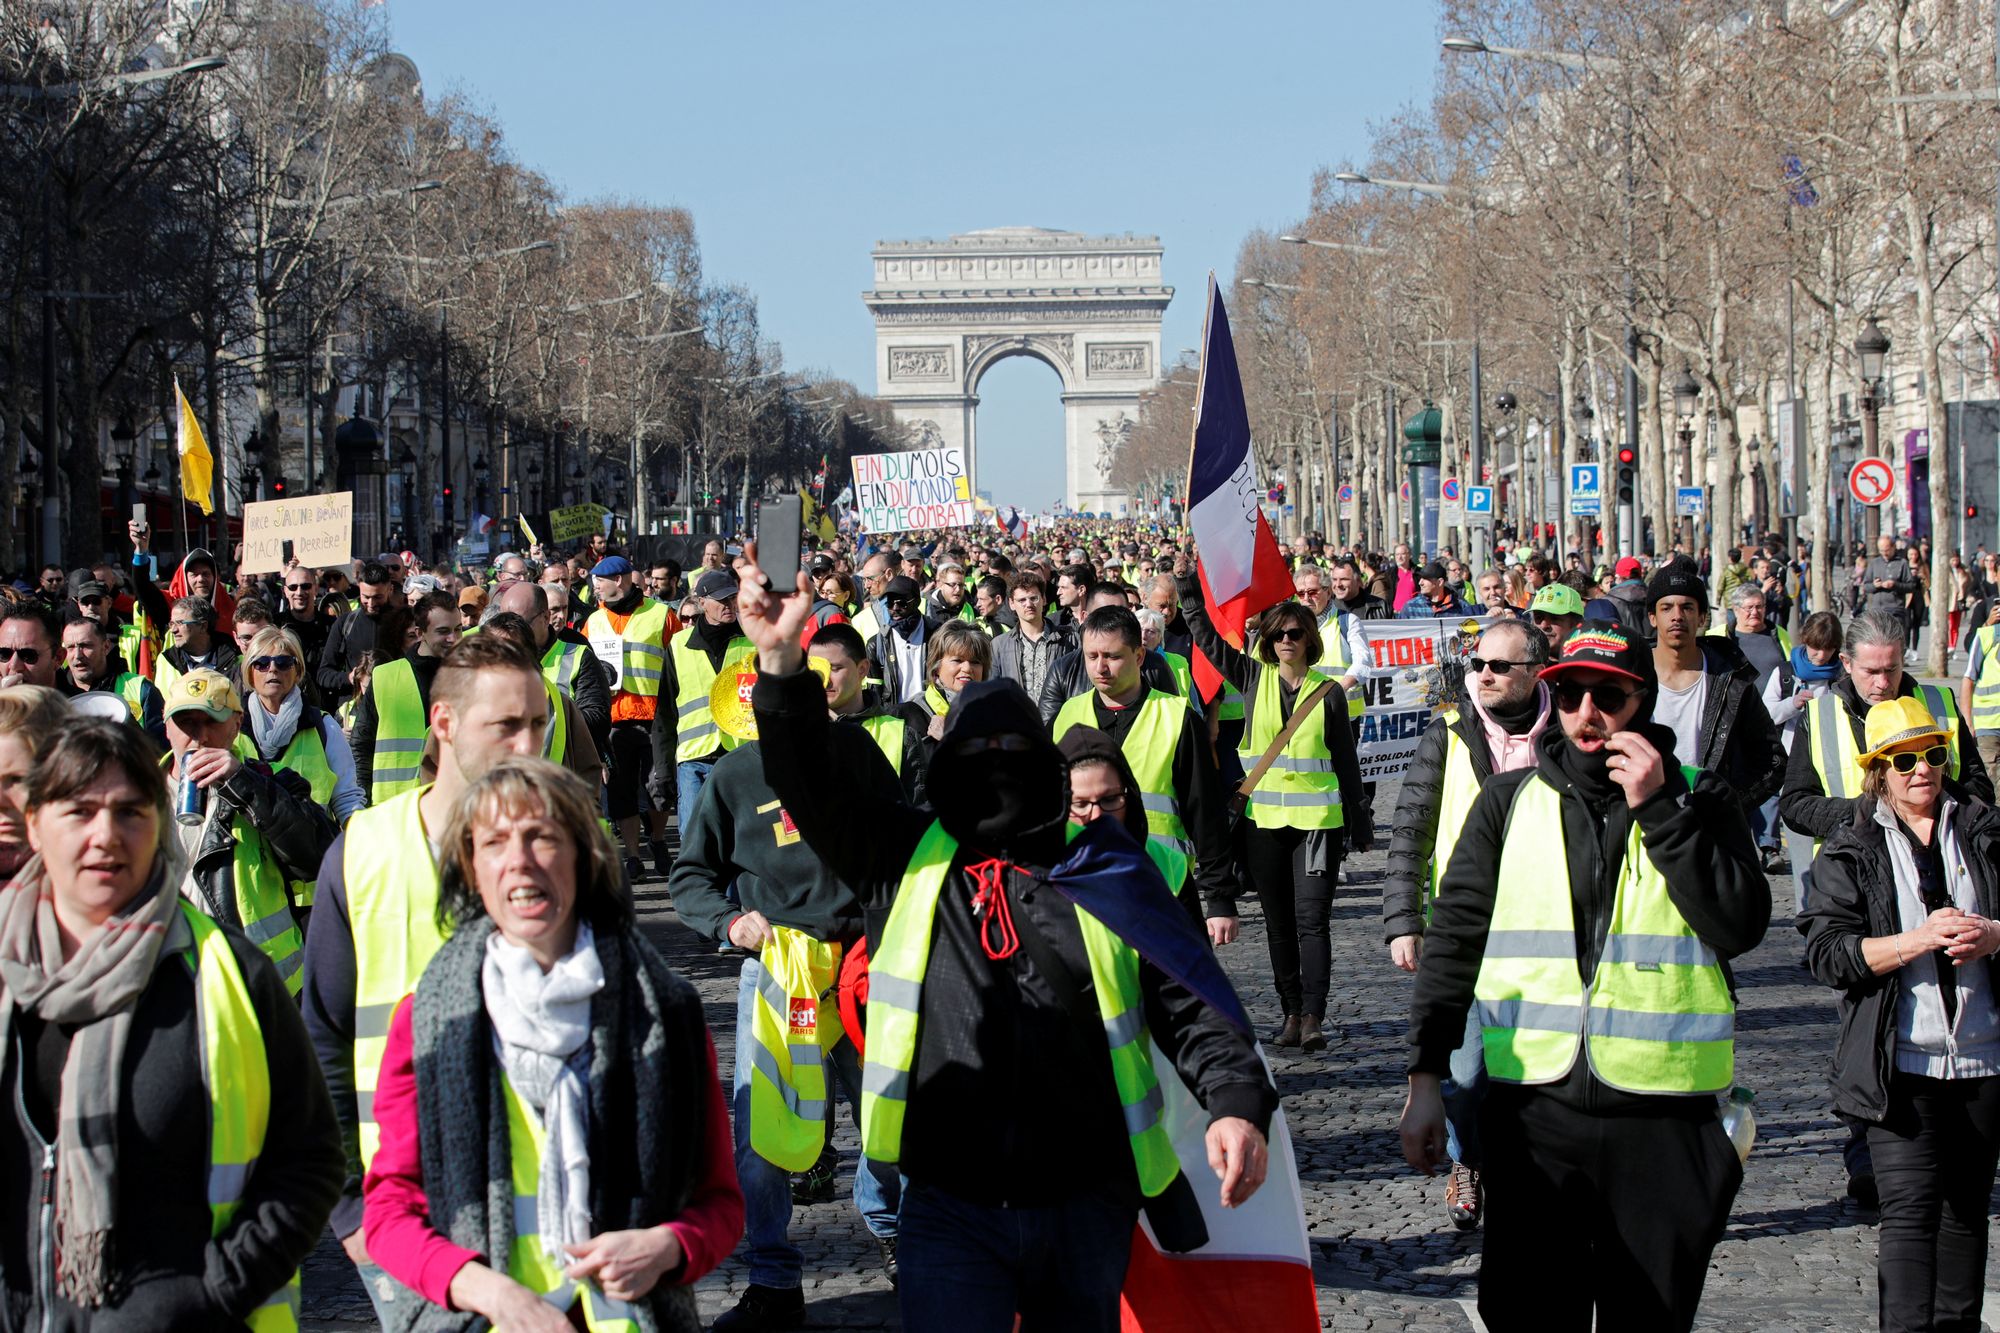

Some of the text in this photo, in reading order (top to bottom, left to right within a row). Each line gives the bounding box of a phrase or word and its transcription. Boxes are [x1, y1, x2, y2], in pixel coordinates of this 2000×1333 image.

[855, 450, 961, 482] FIN DU MOIS
[1578, 470, 1592, 491] P
[860, 475, 969, 508] FIN DU MONDE
[1472, 491, 1485, 508] P
[907, 502, 971, 529] COMBAT
[246, 537, 295, 561] MACR
[738, 684, 755, 702] cg
[1360, 710, 1432, 743] ANCE
[1360, 756, 1373, 765] DE
[1370, 767, 1382, 776] ET
[1383, 764, 1400, 775] LES
[1402, 762, 1411, 771] R
[791, 1008, 815, 1026] cgt
